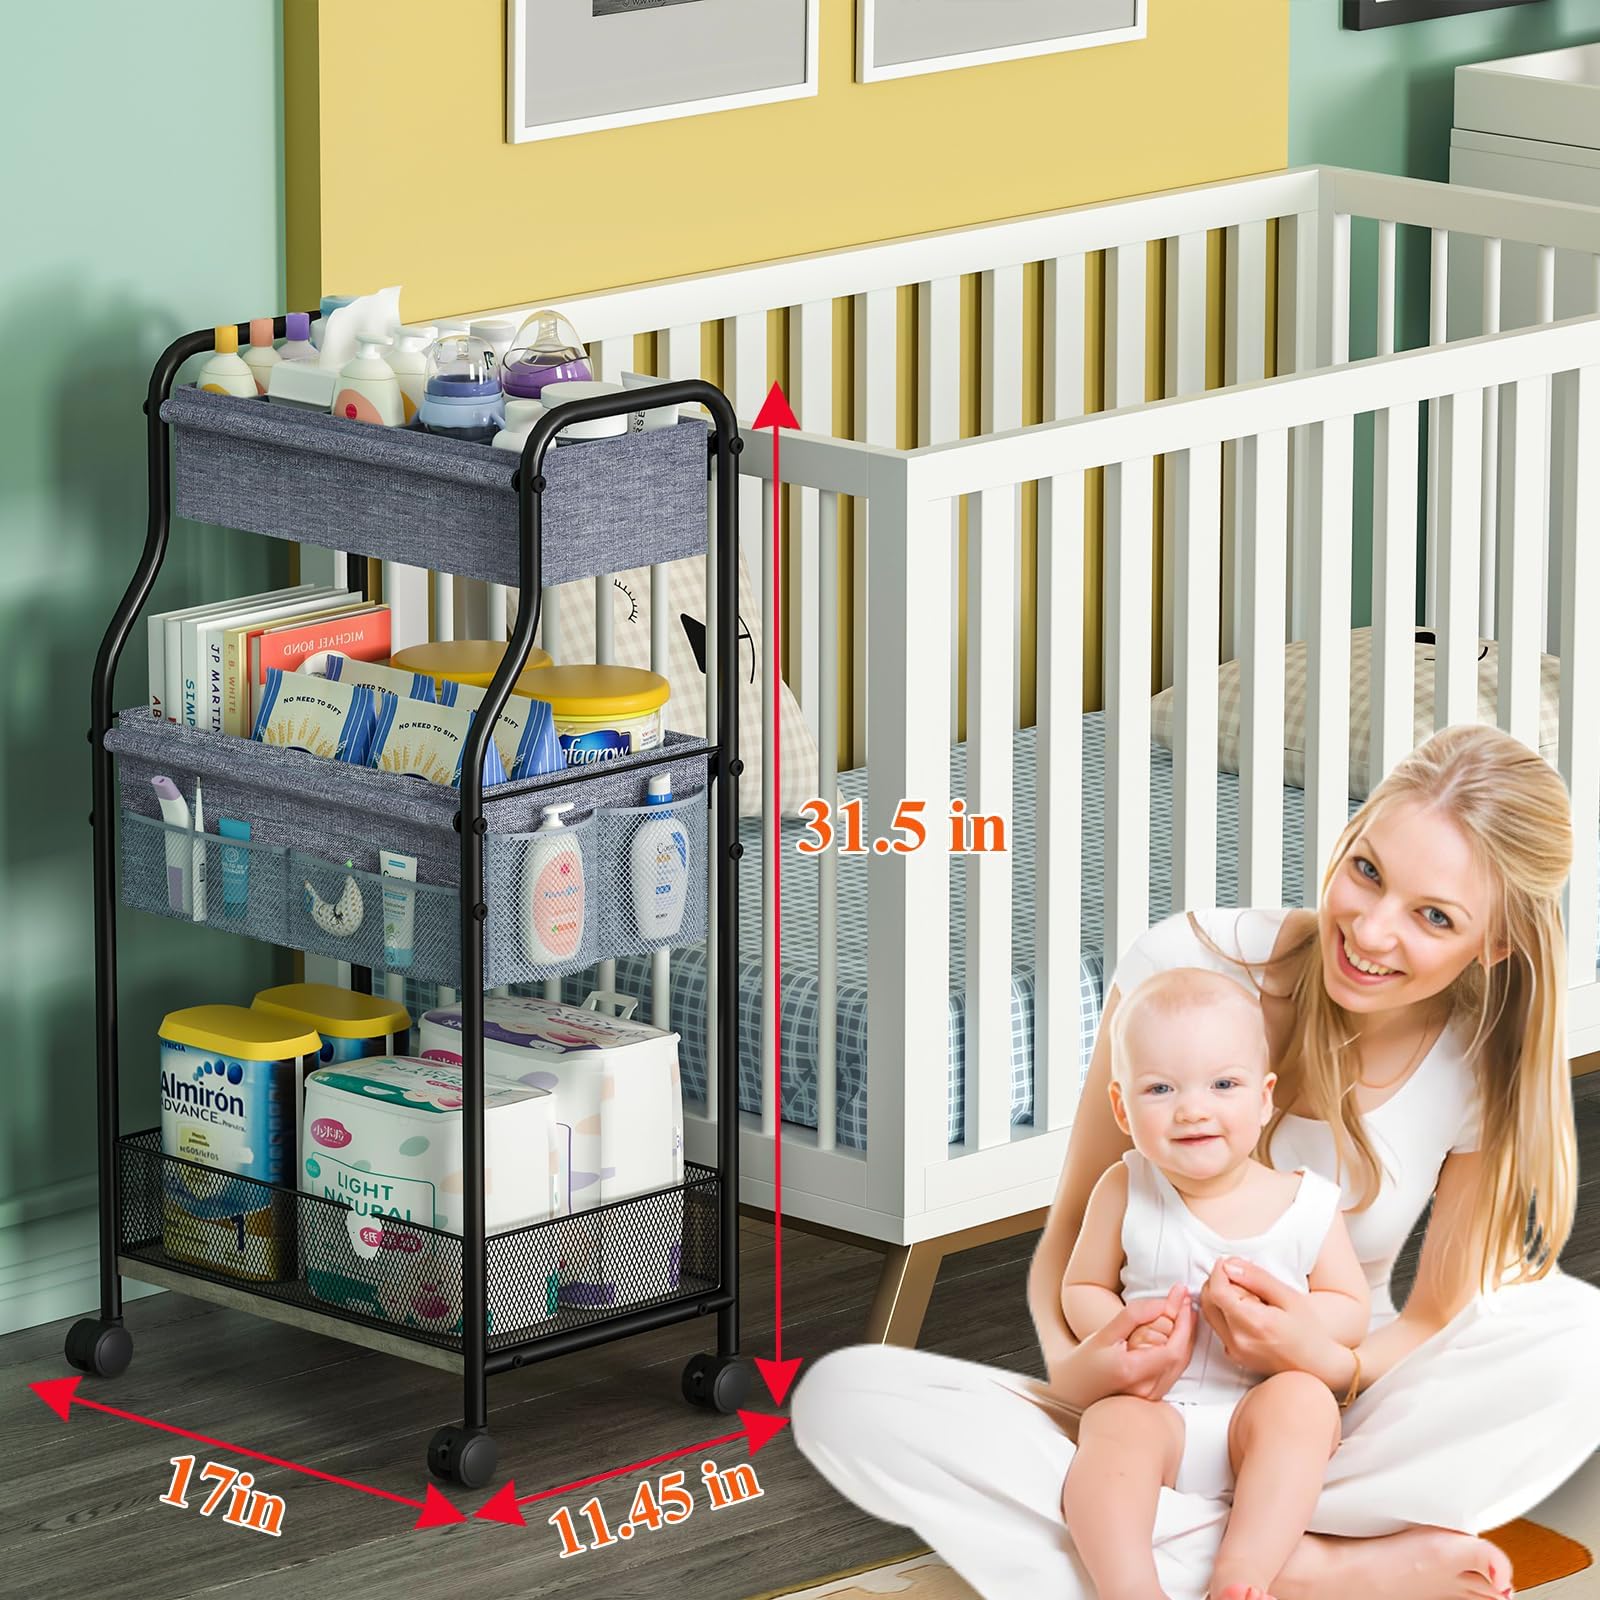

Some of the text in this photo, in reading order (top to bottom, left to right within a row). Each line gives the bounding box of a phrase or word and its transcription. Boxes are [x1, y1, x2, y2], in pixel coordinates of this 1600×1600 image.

[210, 643, 221, 664] JP
[152, 695, 162, 718] AB
[185, 679, 196, 727] SIMP
[228, 676, 236, 714] WHITE
[283, 695, 342, 716] NO NEED TO SIFT
[398, 721, 459, 743] NO NEED TO SIFT
[503, 715, 519, 729] SIFT
[160, 1069, 245, 1118] Almirón
[161, 1097, 218, 1125] DVANCE
[337, 1171, 394, 1201] LIGHT
